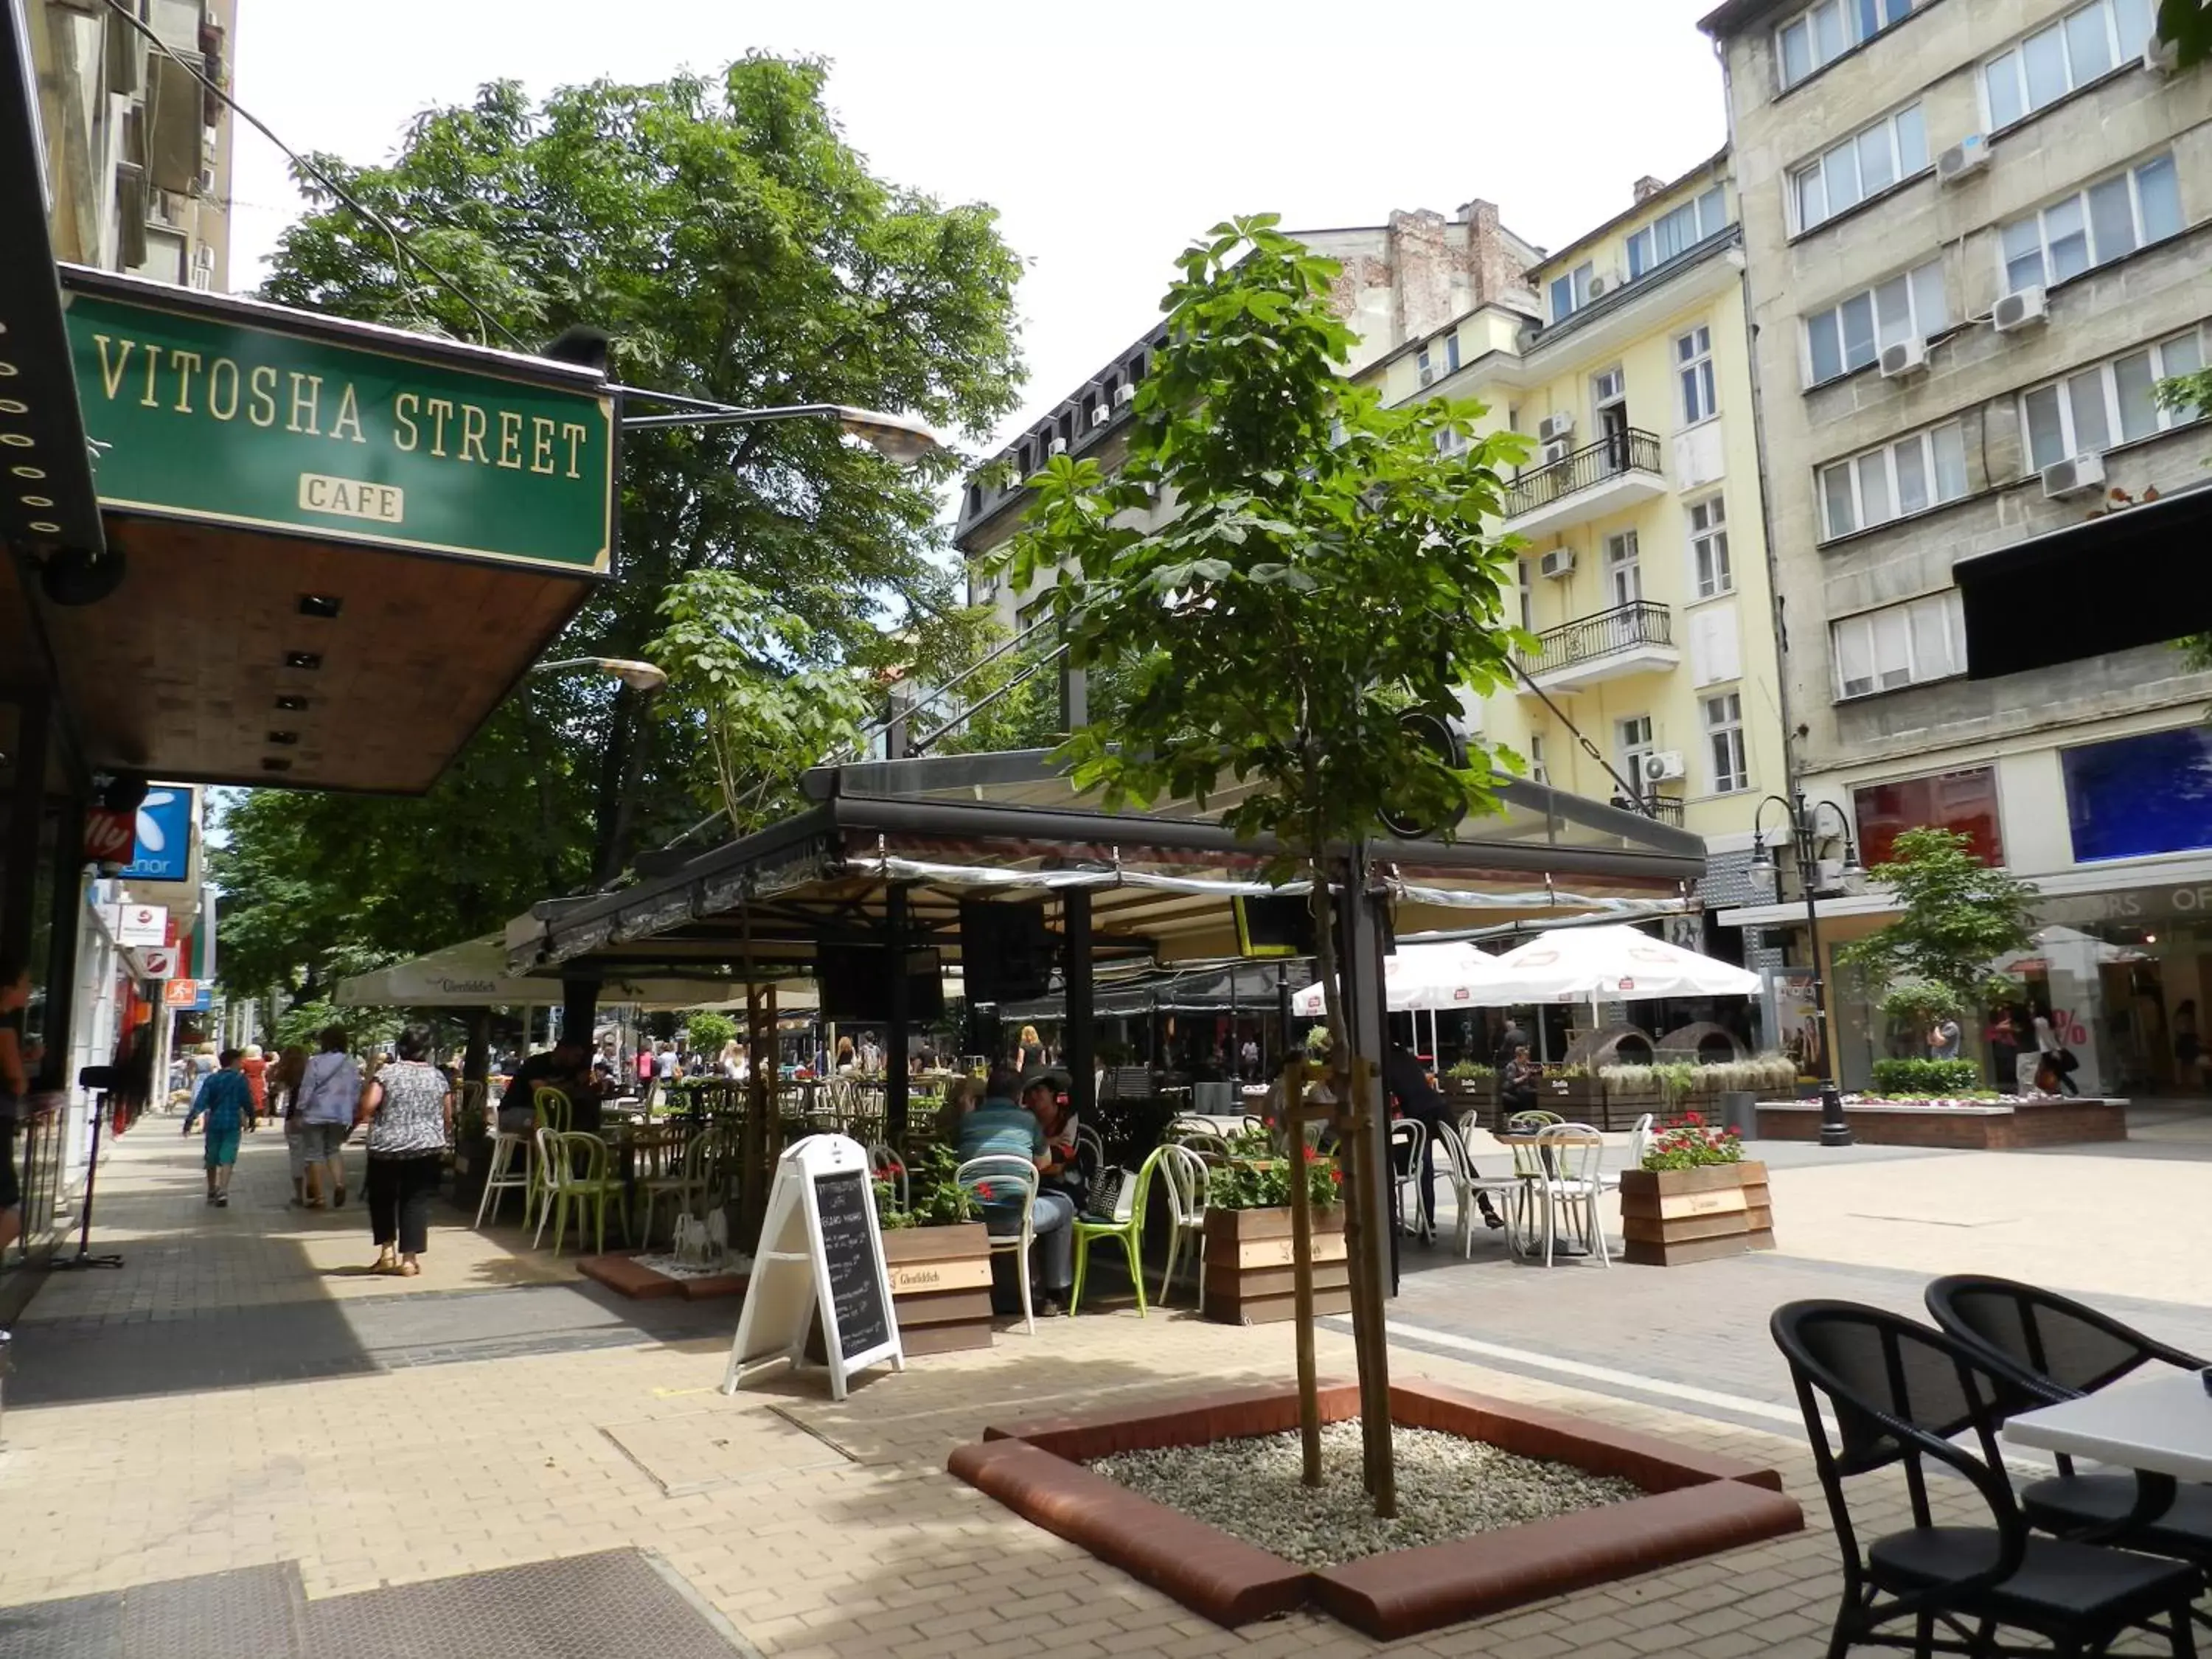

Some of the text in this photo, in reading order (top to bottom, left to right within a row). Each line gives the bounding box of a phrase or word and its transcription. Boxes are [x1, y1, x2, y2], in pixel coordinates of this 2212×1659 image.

[93, 334, 586, 479] VITOSHA STREET
[308, 479, 396, 518] CAFE
[83, 813, 131, 856] lly
[122, 858, 171, 874] enor
